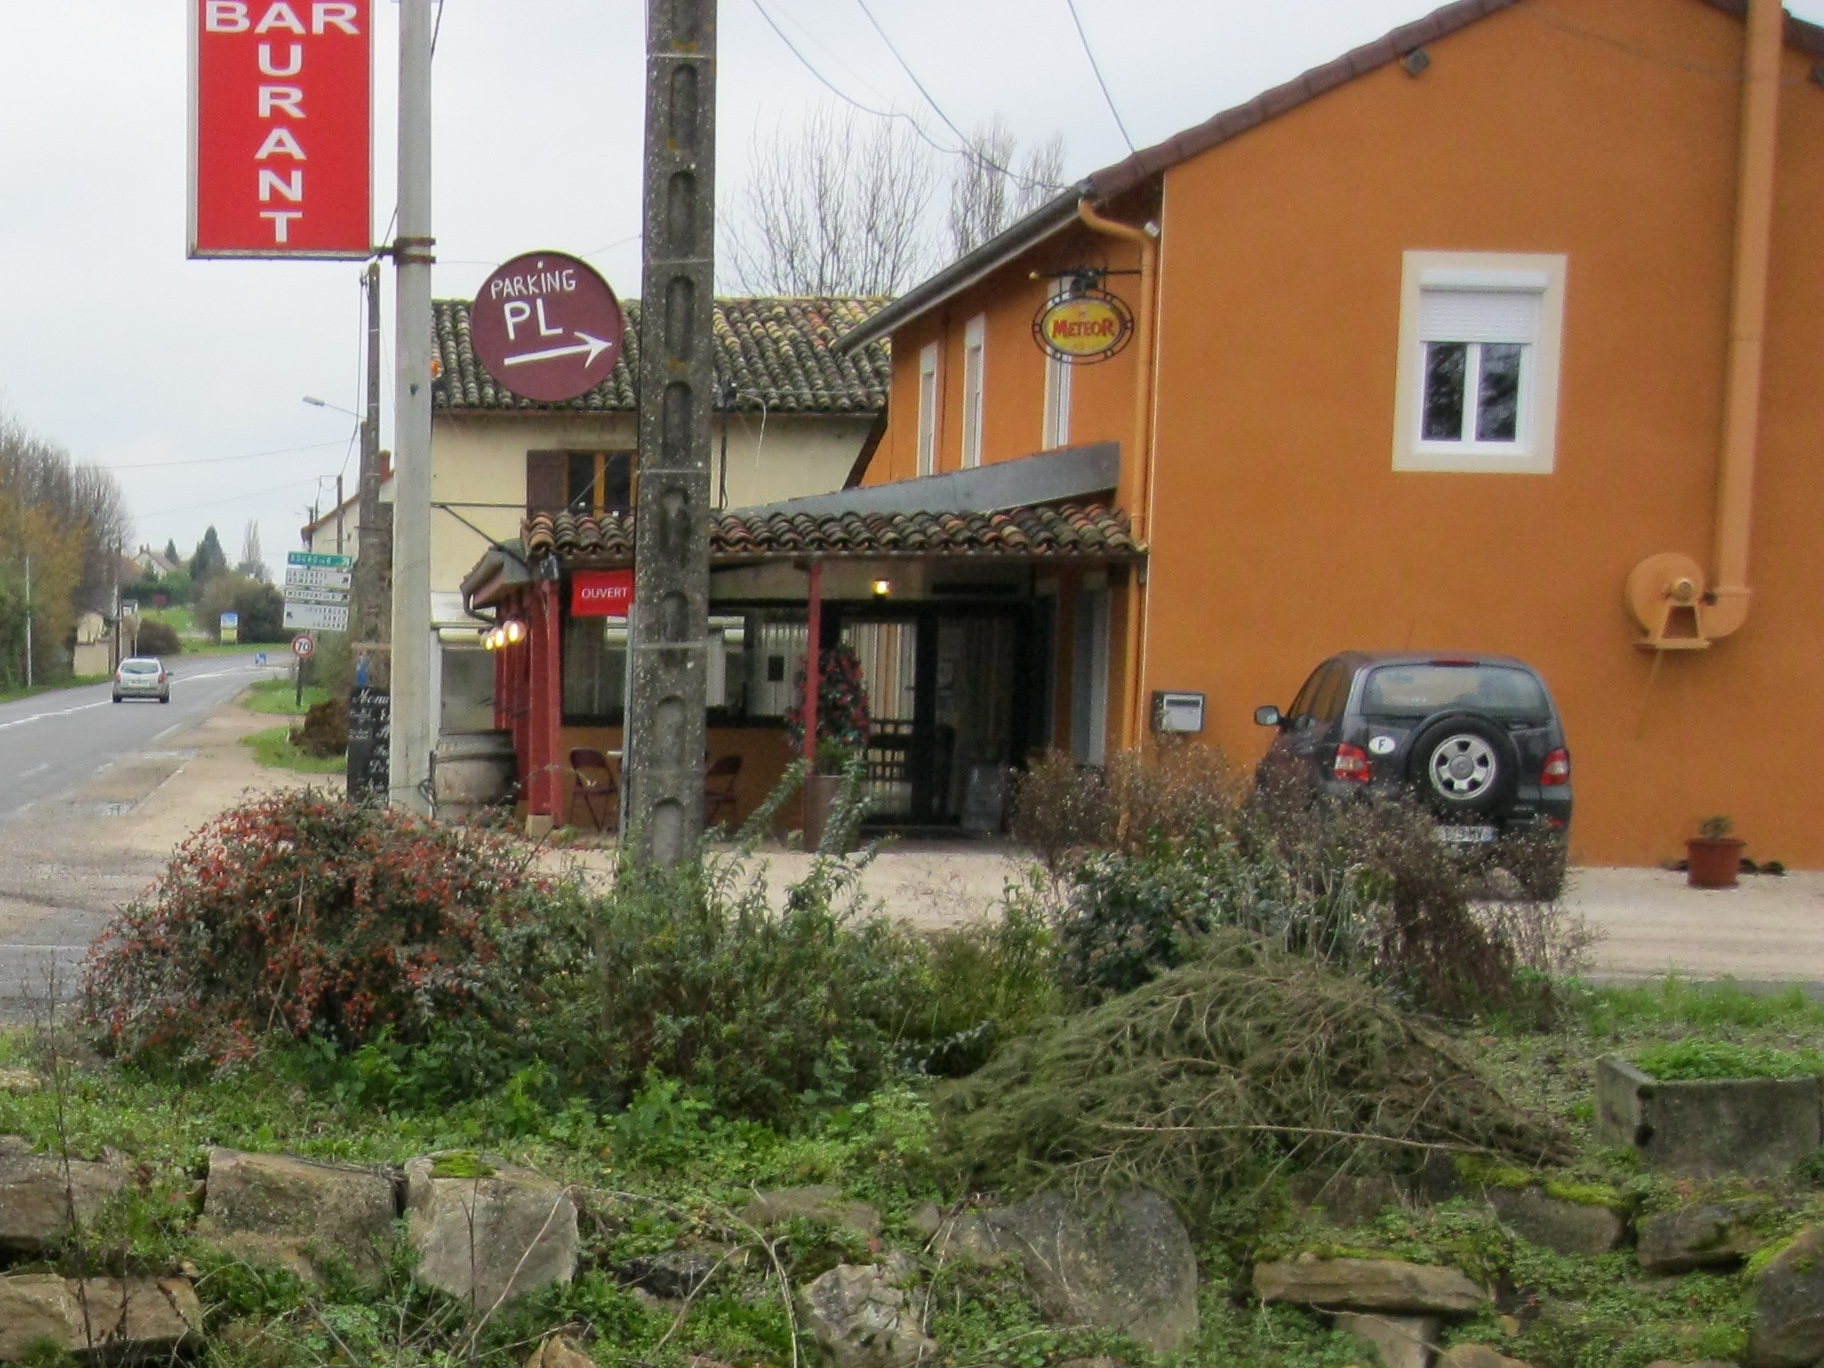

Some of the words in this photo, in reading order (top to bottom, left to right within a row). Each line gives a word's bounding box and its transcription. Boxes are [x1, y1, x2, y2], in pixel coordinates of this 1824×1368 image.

[205, 2, 361, 35] BAR
[490, 268, 577, 300] PARKING
[503, 297, 564, 341] PL
[581, 587, 628, 599] OUVERT
[297, 641, 310, 651] 70
[1378, 739, 1386, 751] F
